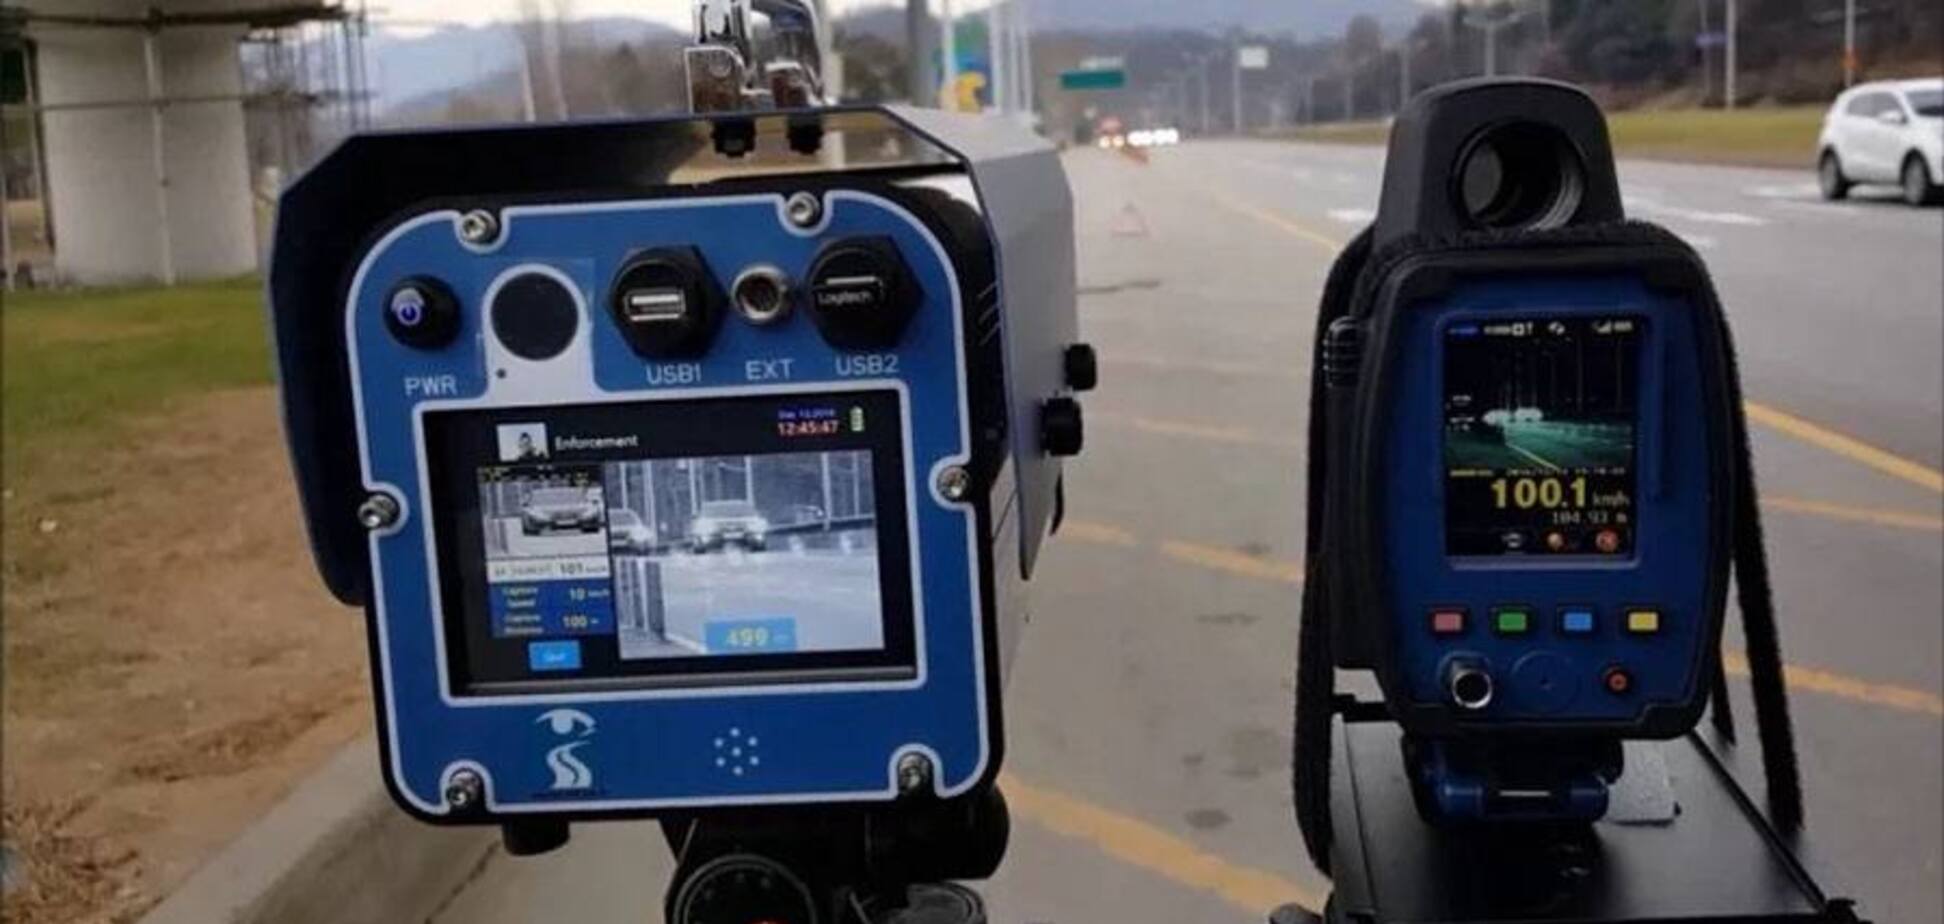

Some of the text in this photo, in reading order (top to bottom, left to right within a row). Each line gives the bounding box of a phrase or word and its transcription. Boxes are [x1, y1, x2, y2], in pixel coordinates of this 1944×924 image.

[645, 364, 702, 385] USB1
[746, 358, 794, 381] EXT
[835, 354, 899, 376] USB2
[405, 377, 457, 397] PWR
[554, 434, 638, 451] Enforcement
[1491, 477, 1586, 509] 100.1
